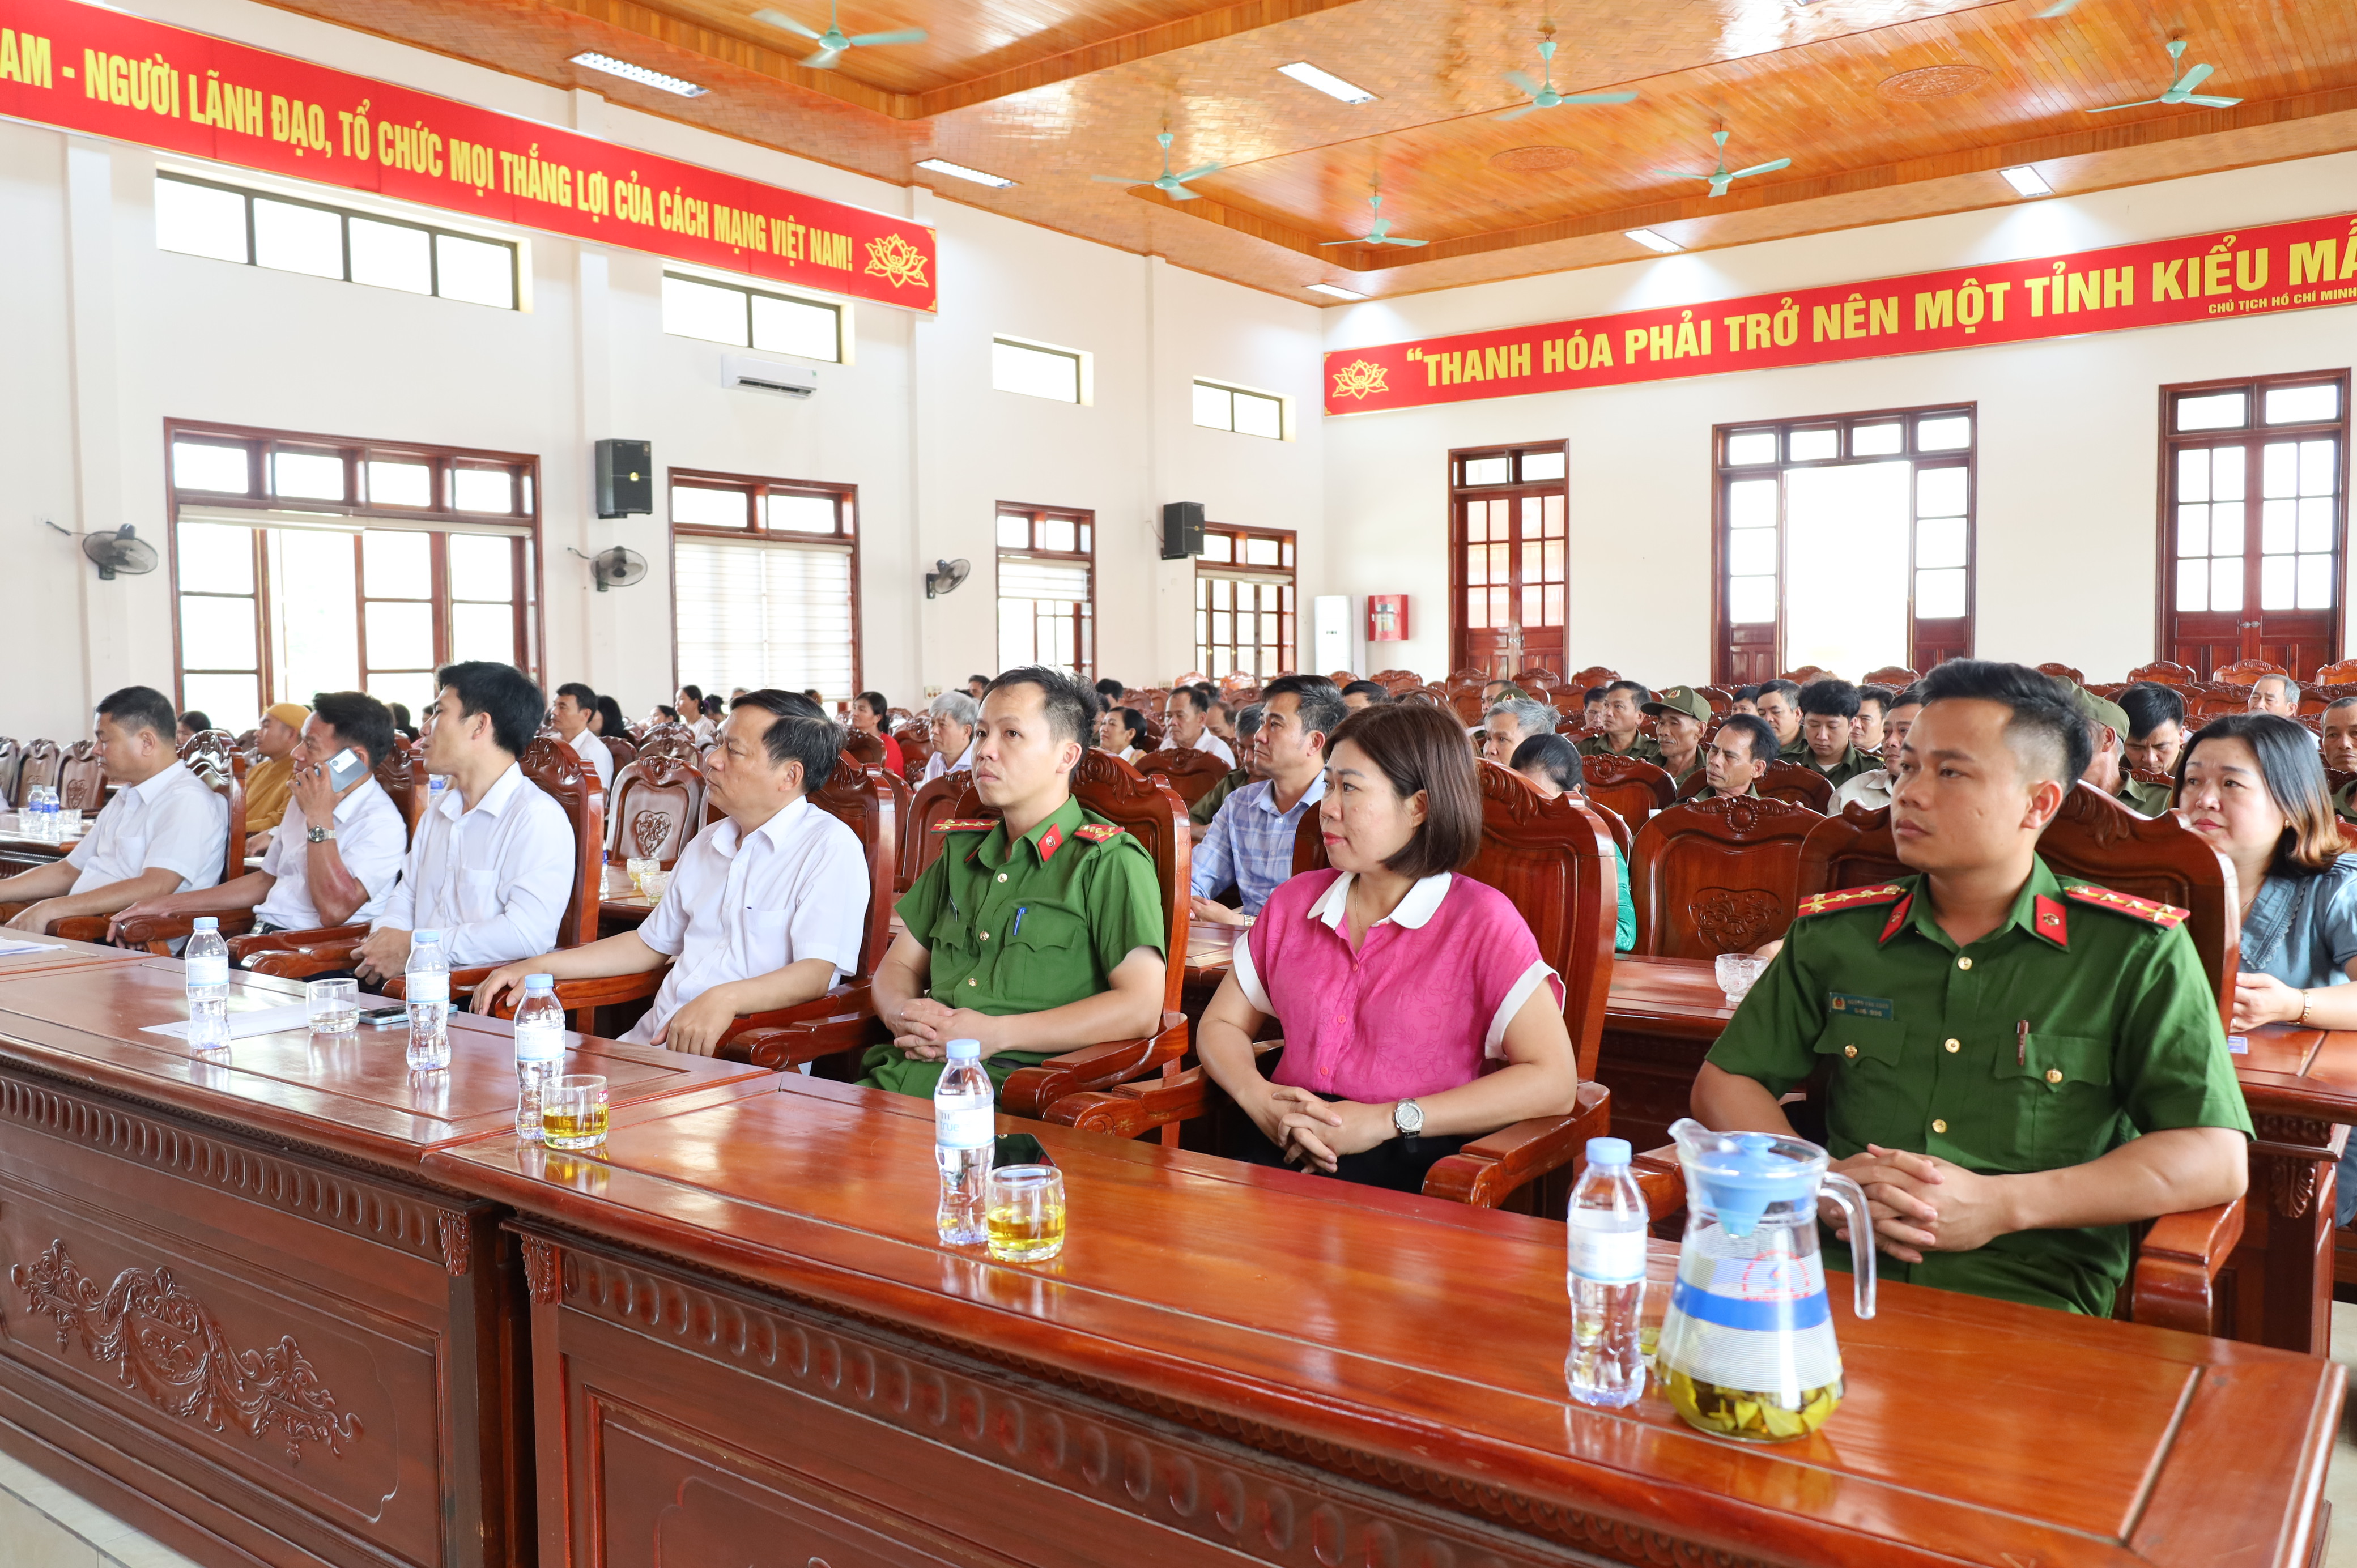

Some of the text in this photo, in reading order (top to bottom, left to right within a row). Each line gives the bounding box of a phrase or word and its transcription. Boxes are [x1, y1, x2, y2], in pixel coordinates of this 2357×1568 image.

[84, 49, 180, 118] NGƯỜI
[189, 69, 264, 137] LÃNH
[271, 94, 333, 158] ĐẠO,
[339, 99, 371, 161] TỔ
[378, 121, 443, 178] CHỨC
[450, 139, 495, 197] MỌI
[500, 143, 572, 207] THẮNG
[577, 170, 610, 223] LỢI
[614, 169, 655, 227] CỦA
[659, 186, 709, 239] CÁCH
[714, 204, 767, 254] MẠNG
[771, 215, 806, 267] VIỆT
[810, 228, 853, 271] NAM!
[1543, 329, 1614, 374] HÓA
[1625, 309, 1712, 364] PHẢI
[1724, 297, 1800, 352] TRỞ
[1813, 293, 1899, 343] NÊN
[1914, 278, 2011, 334] MỘT
[2024, 261, 2134, 317] TỈNH
[2152, 235, 2269, 302] KIỂU
[2208, 287, 2357, 314] CHỦ TỊCH HỒ CHÍ MINH
